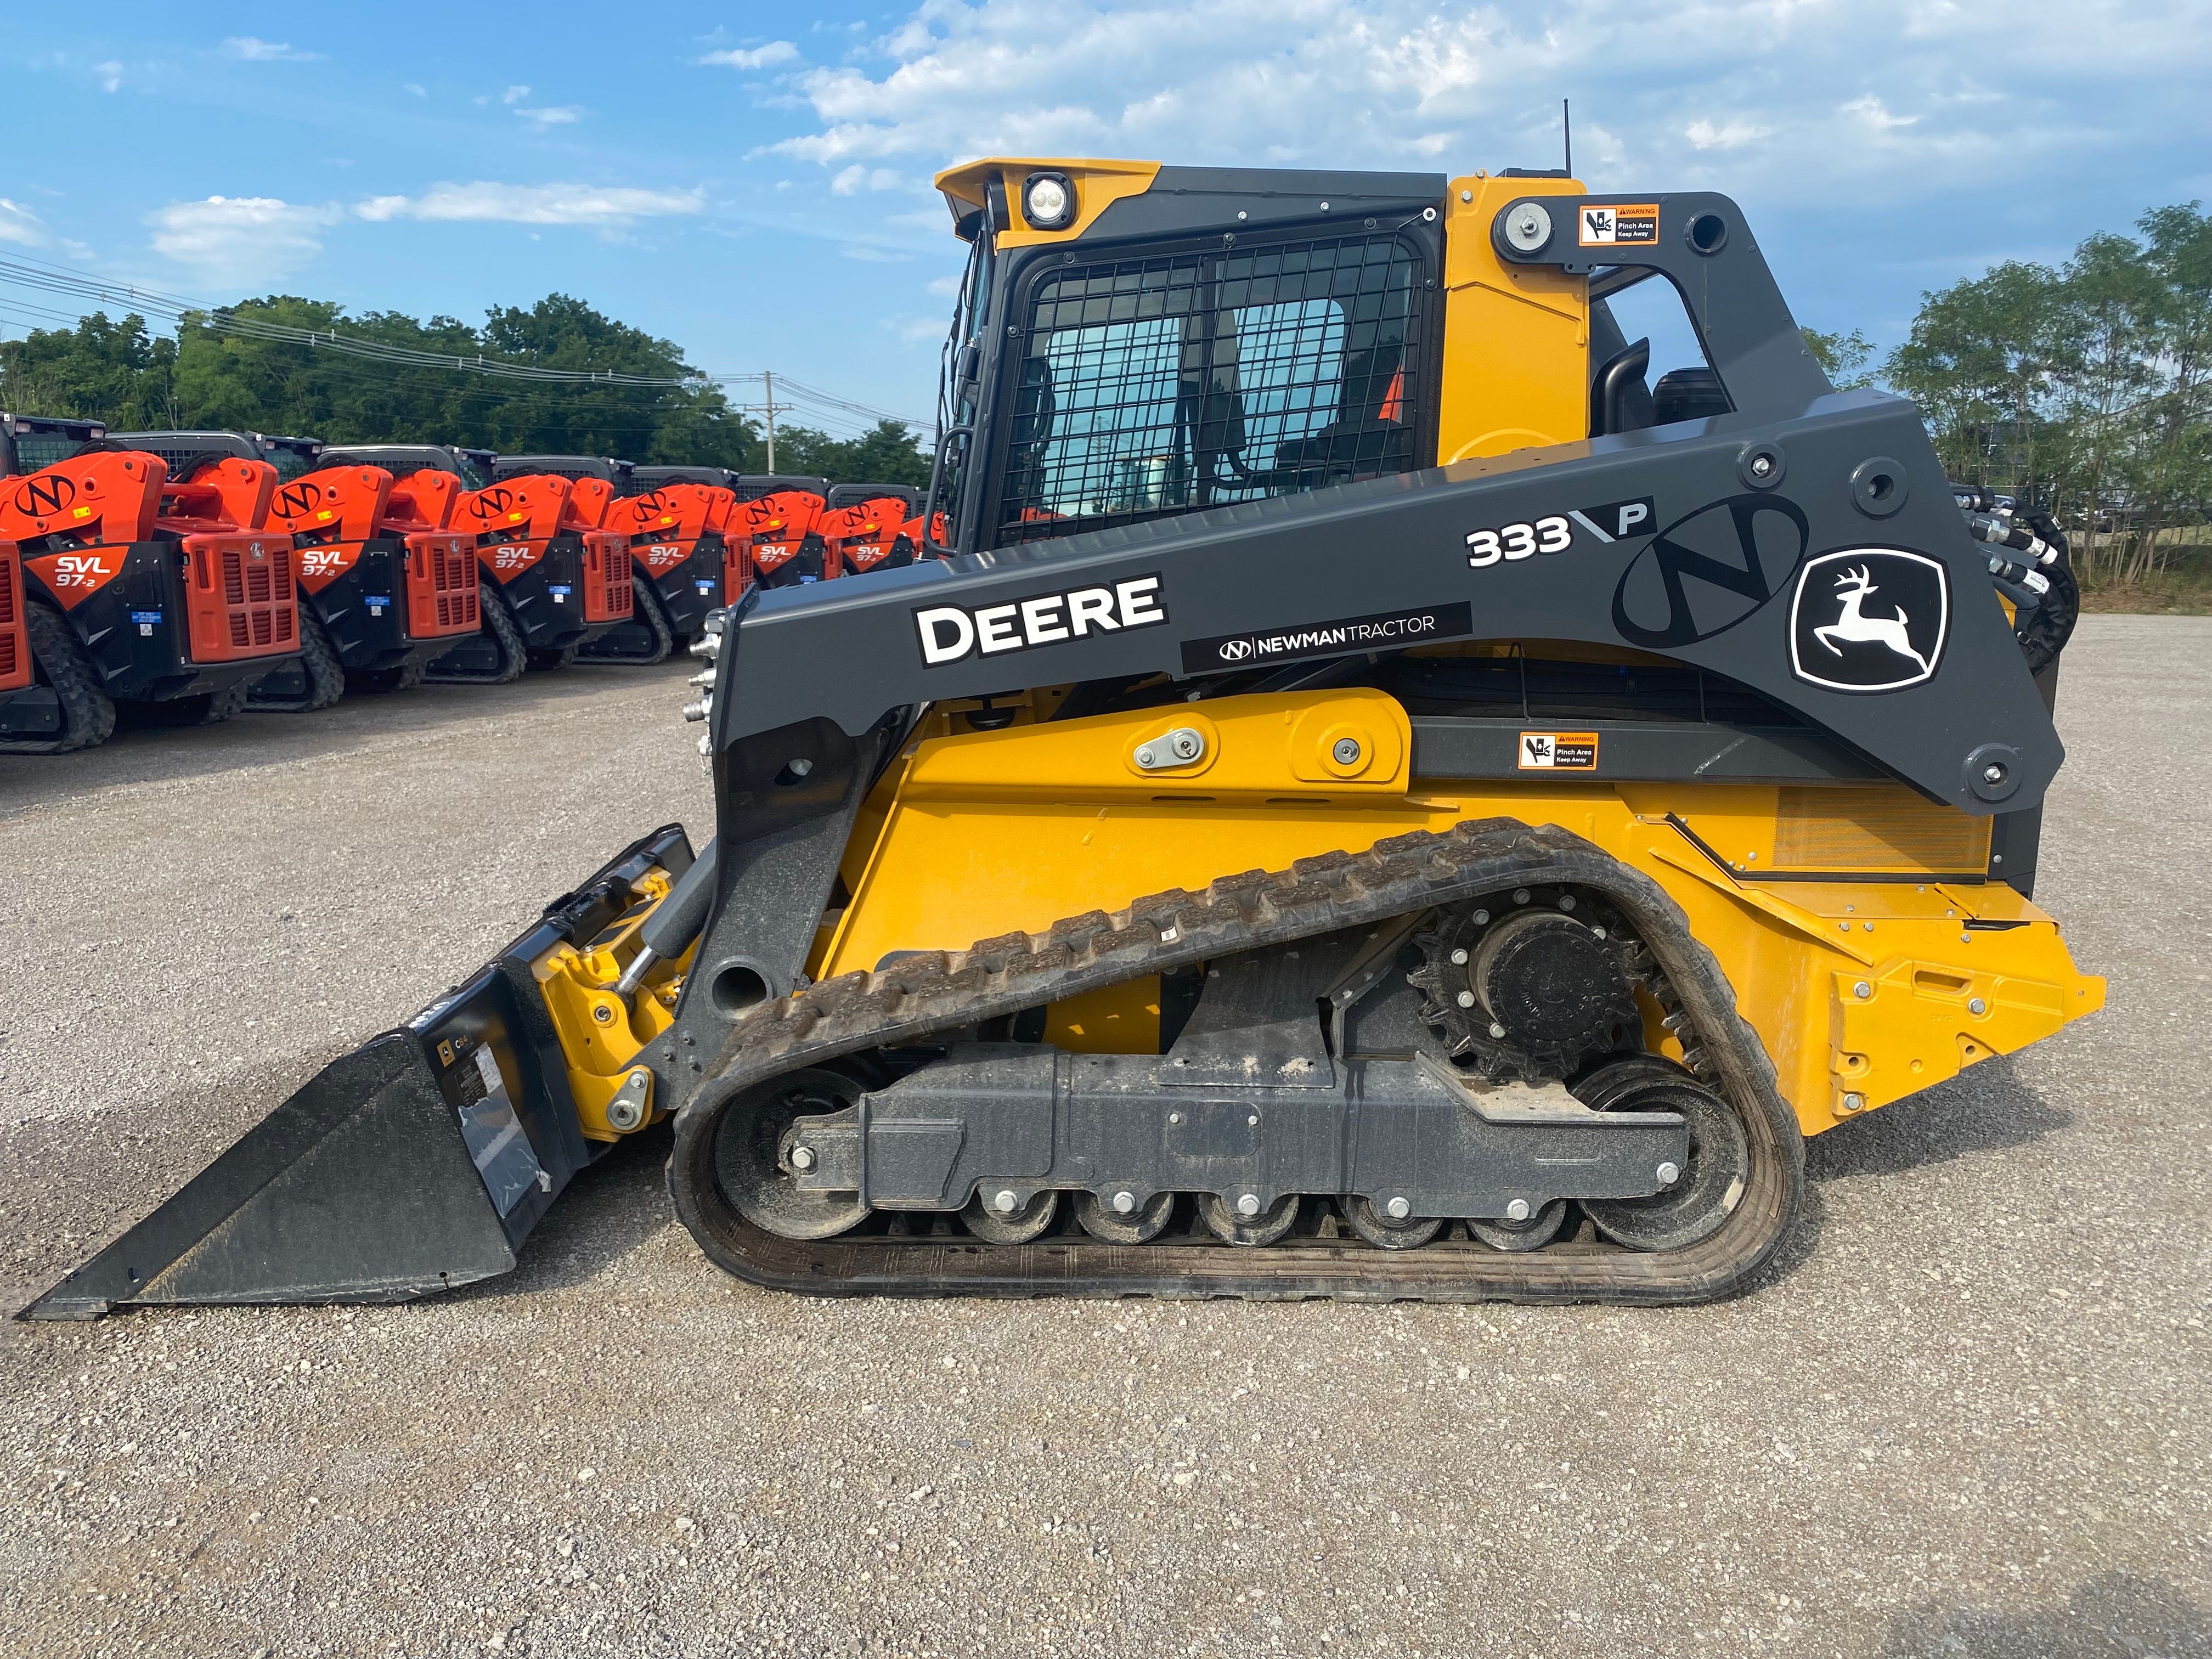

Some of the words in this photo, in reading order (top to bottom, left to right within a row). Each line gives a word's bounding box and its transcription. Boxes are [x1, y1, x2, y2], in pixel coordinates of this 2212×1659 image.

[1466, 516, 1571, 567] 333
[495, 547, 536, 559] SVL
[648, 546, 684, 557] SVL
[759, 546, 792, 556] SVL
[856, 546, 885, 555] SVL
[302, 551, 348, 565] SVL
[495, 559, 524, 568] 97-2
[648, 557, 674, 566] 97-2
[55, 556, 111, 573] SVL
[302, 565, 335, 576] 97-2
[56, 574, 95, 587] 97-2
[916, 577, 1164, 664] DEERE
